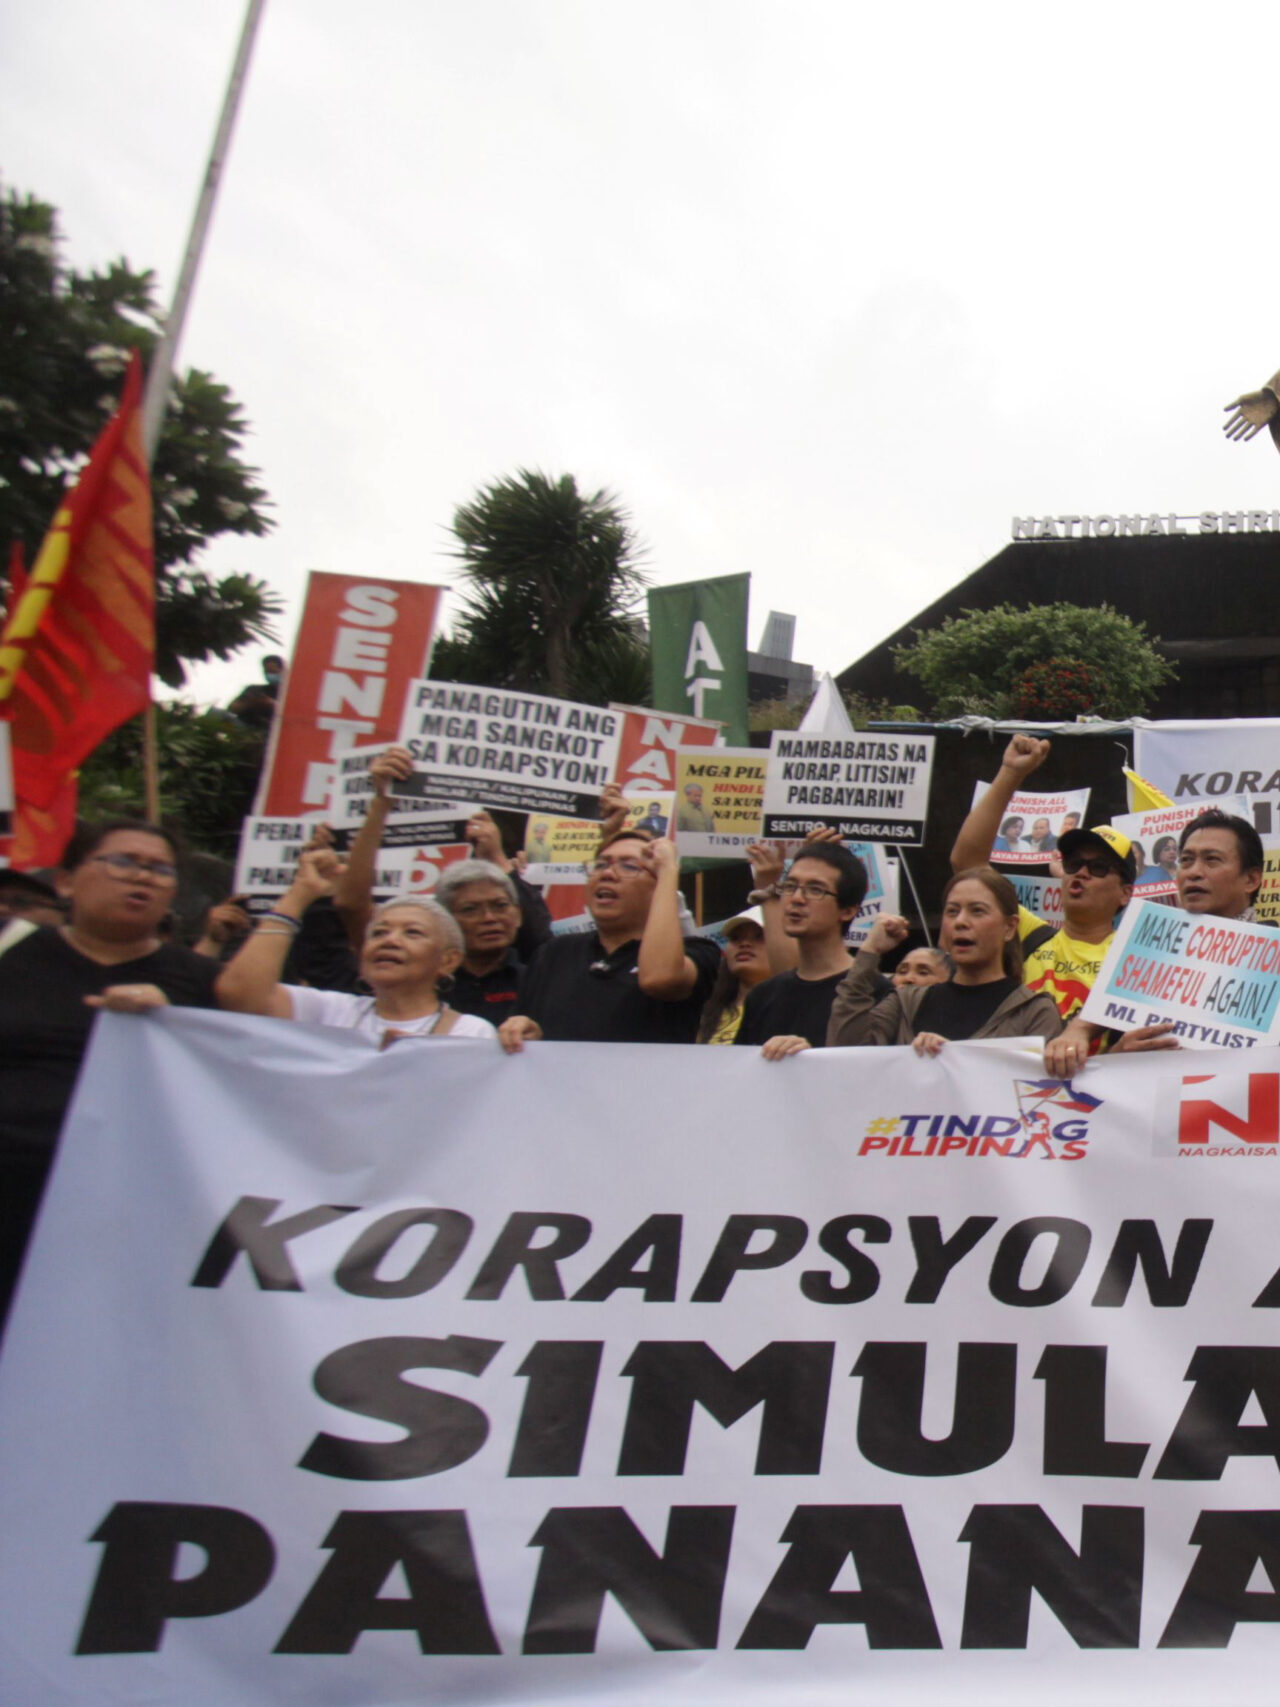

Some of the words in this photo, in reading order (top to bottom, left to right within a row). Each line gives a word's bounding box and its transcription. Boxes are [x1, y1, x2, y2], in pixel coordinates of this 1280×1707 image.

[1010, 513, 1187, 540] NATIONAL
[299, 584, 400, 818] SENTR
[416, 686, 561, 726] PANAGUTIN
[566, 708, 617, 737] ANG
[419, 714, 477, 741] MGA
[485, 721, 604, 761] SANGKOT
[406, 739, 437, 763] SA
[445, 744, 609, 786] KORAPSYON!
[777, 739, 899, 762] MAMBABATAS
[903, 743, 927, 763] NA
[686, 764, 732, 778] MGA
[782, 762, 841, 783] KORAP,
[845, 764, 916, 785] LITISIN!
[713, 784, 752, 794] HINDI
[787, 785, 904, 809] PAGBAYARIN!
[713, 797, 732, 807] SA
[1048, 797, 1066, 805] ALL
[712, 810, 731, 820] NA
[1143, 808, 1194, 825] PUNISH
[255, 822, 303, 841] PERA
[708, 835, 757, 846] TINDIG
[770, 820, 827, 833] SENTRO
[839, 822, 916, 838] NAGKAISA
[1133, 881, 1180, 894] AKBAYA
[1134, 913, 1190, 955] MAKE
[1115, 954, 1206, 1007] SHAMEFUL
[1203, 975, 1278, 1027] AGAIN!
[1104, 1002, 1137, 1025] ML
[1178, 1146, 1278, 1158] NAGKAISA
[190, 1195, 1214, 1308] KORAPSYON
